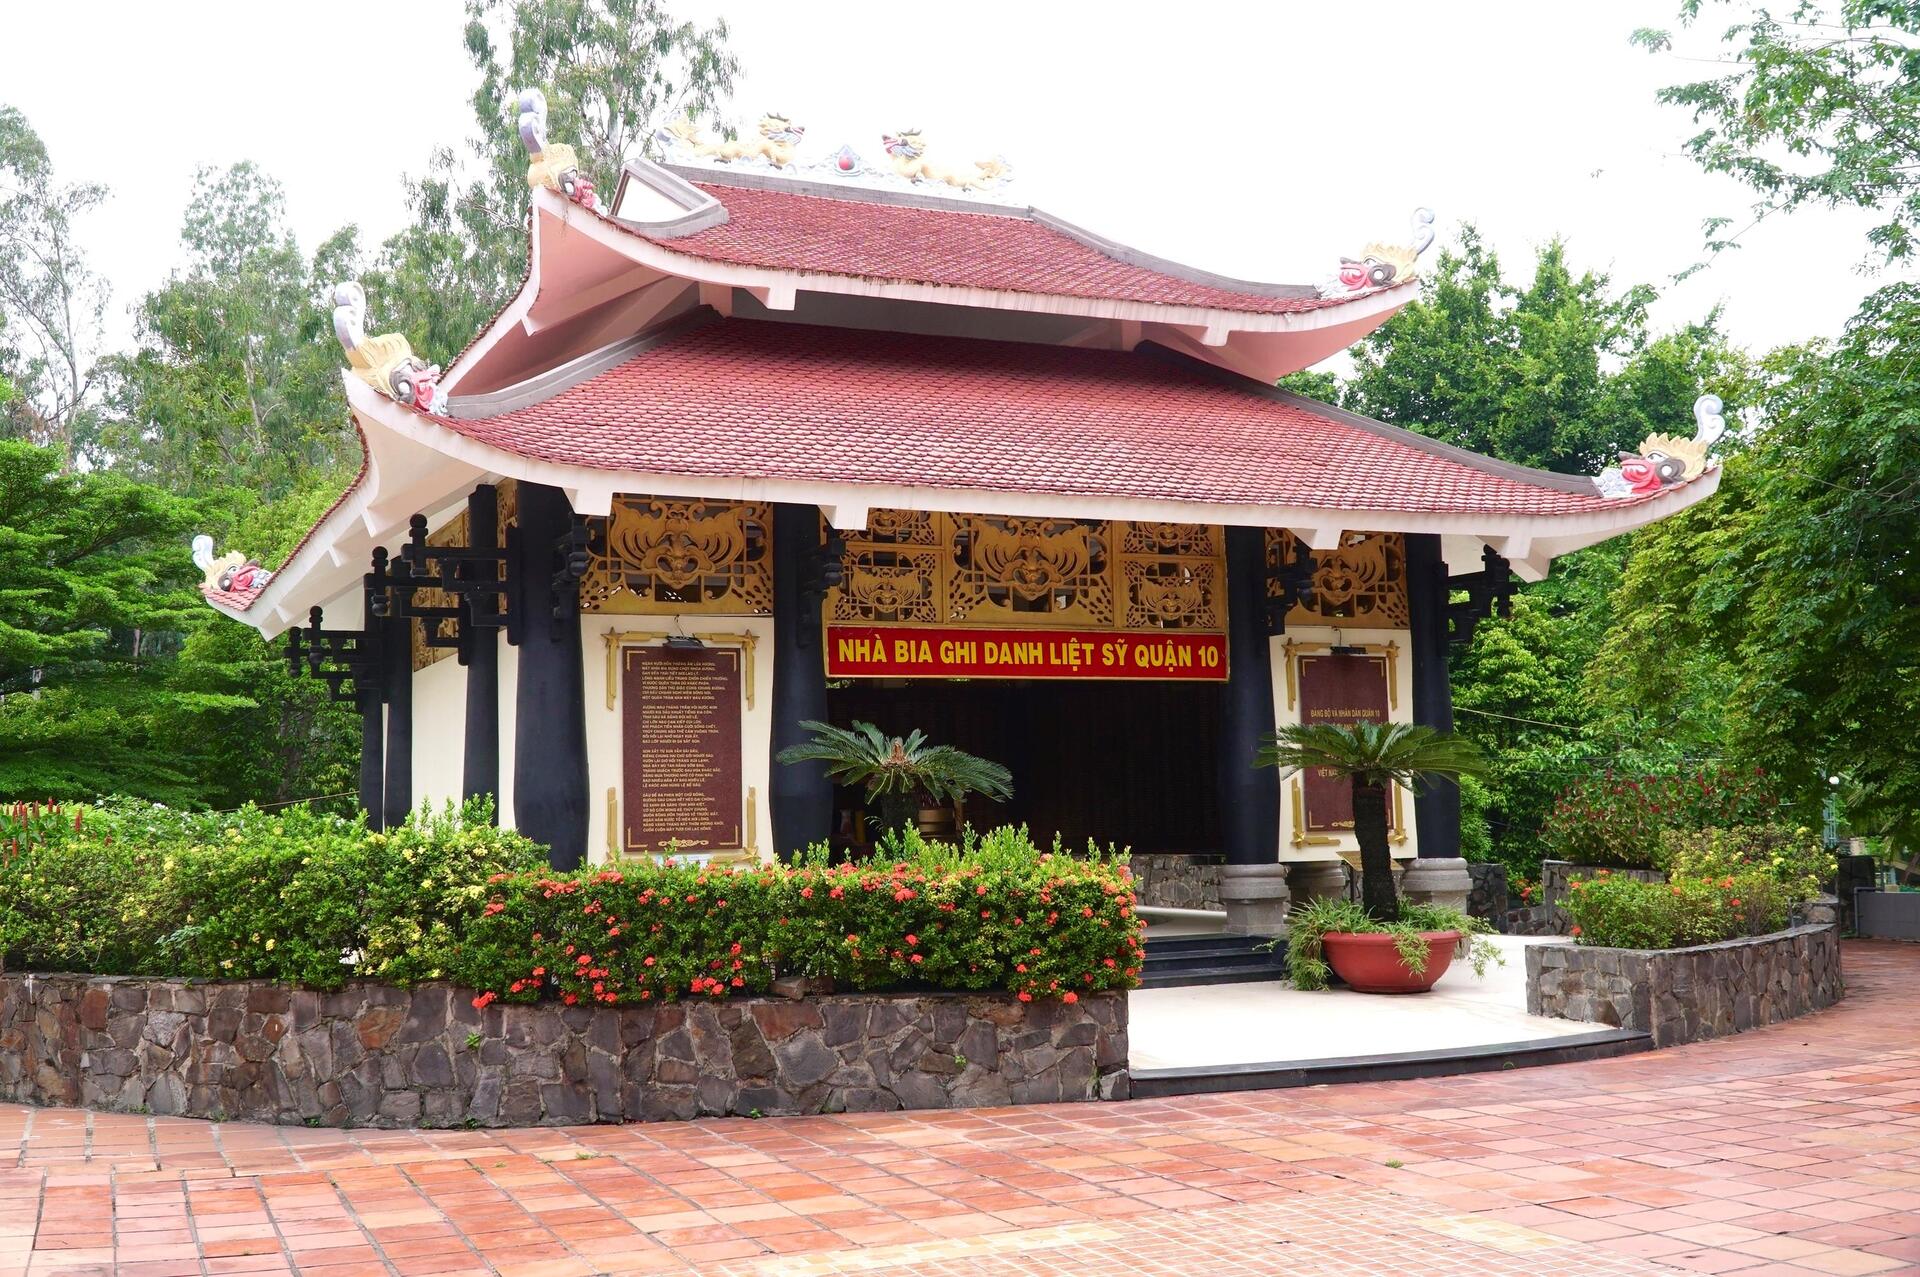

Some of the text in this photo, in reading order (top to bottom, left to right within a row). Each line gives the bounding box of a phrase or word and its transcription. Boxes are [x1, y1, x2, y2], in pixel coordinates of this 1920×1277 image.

[838, 634, 1218, 672] NHÀ BIA GHI DANH LIỆT SỸ QUẬN 10
